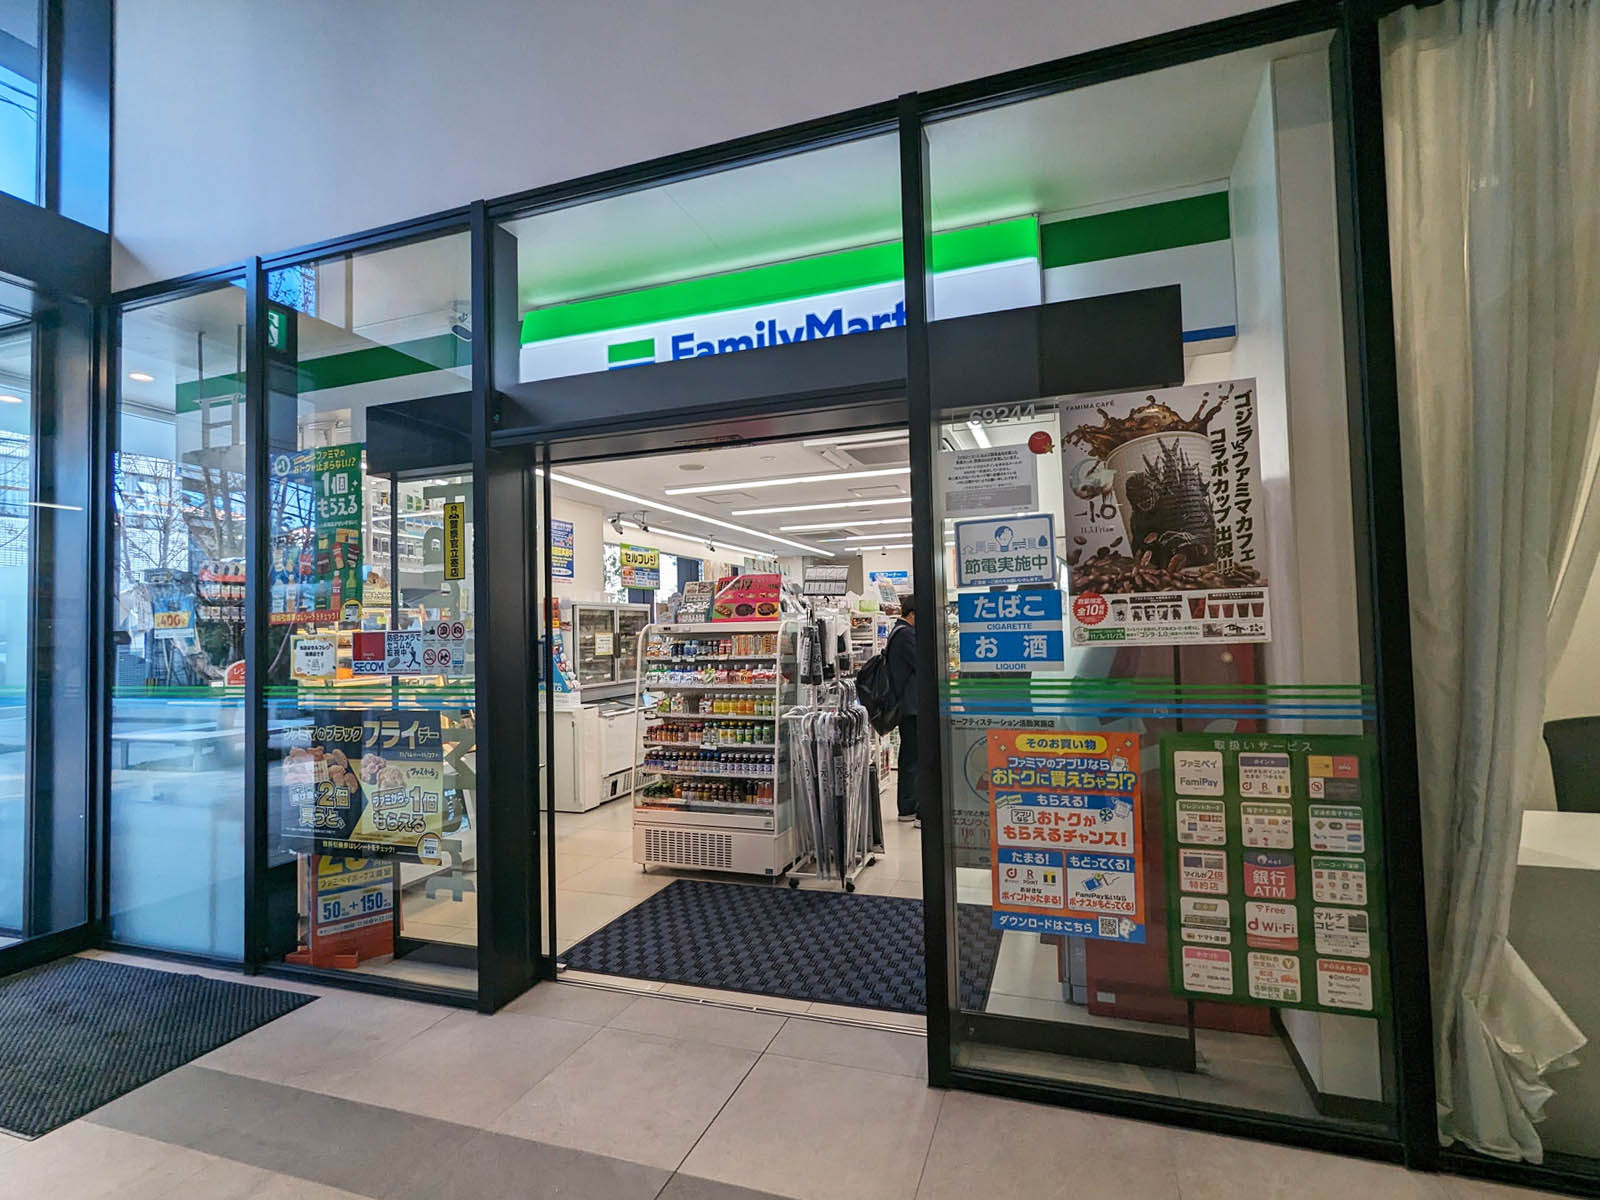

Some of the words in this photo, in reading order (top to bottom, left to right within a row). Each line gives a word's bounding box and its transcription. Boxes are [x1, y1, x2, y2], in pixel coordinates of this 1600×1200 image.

[969, 403, 1036, 426] 69244
[321, 471, 348, 497] 1個
[317, 494, 358, 518] もらえる
[964, 554, 1048, 576] 節電実施中
[973, 594, 1045, 619] たばこ
[974, 634, 1048, 659] お酒
[353, 661, 385, 672] SECOM
[1026, 738, 1097, 751] そのお買い物
[1214, 740, 1313, 752] 取扱いサービス
[1008, 756, 1111, 771] ファミマのアプリなら
[1179, 759, 1218, 769] ファミペイ
[992, 768, 1136, 791] おトクに買えちゃう!?
[1180, 776, 1218, 788] FamiPay
[1037, 794, 1089, 808] もらえる!
[373, 812, 427, 833] もらえる
[1037, 810, 1097, 828] おトクが
[1003, 824, 1127, 847] もらえるチャンス!
[1011, 851, 1050, 865] たまる!
[1069, 855, 1131, 871] もどってくる!
[1252, 869, 1288, 887] 銀行
[1001, 891, 1062, 905] ポイントがたまる!
[1253, 886, 1287, 899] ATM
[323, 901, 341, 920] 50
[360, 891, 384, 912] 150
[1264, 905, 1286, 915] Free
[999, 914, 1093, 934] ダウンロードはこちら
[1314, 911, 1345, 922] マルチ
